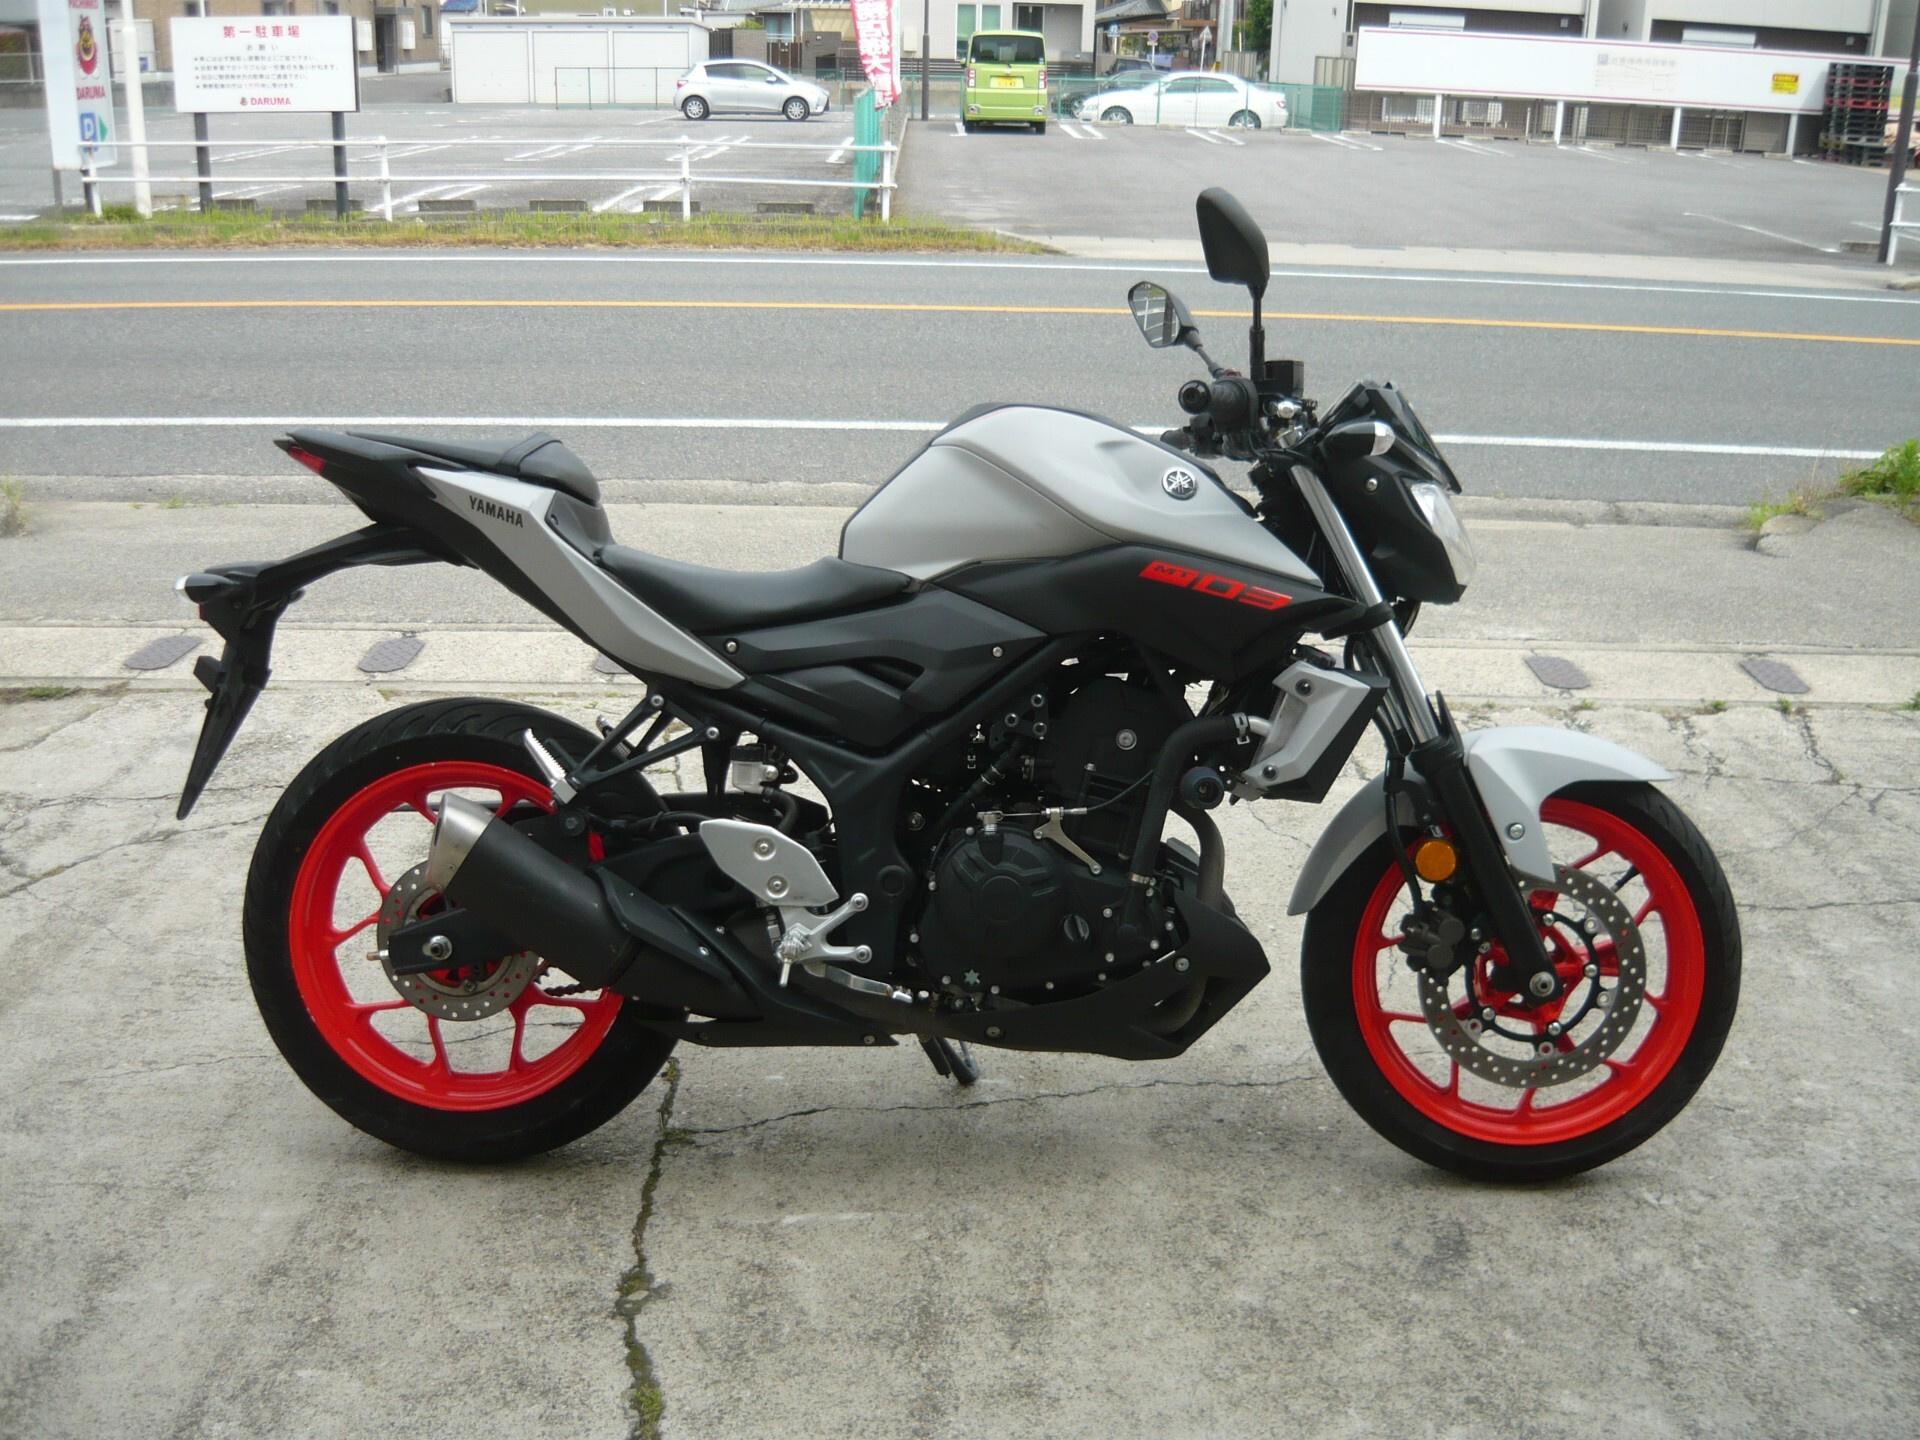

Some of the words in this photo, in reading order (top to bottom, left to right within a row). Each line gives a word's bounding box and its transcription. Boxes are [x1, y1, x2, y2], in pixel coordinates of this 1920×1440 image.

[223, 25, 300, 38] 第一駐車場
[76, 85, 106, 100] DARUMA
[250, 97, 292, 106] DARUMA
[469, 495, 524, 528] YAMAHA
[1153, 564, 1194, 578] MT
[1192, 573, 1293, 610] 03
